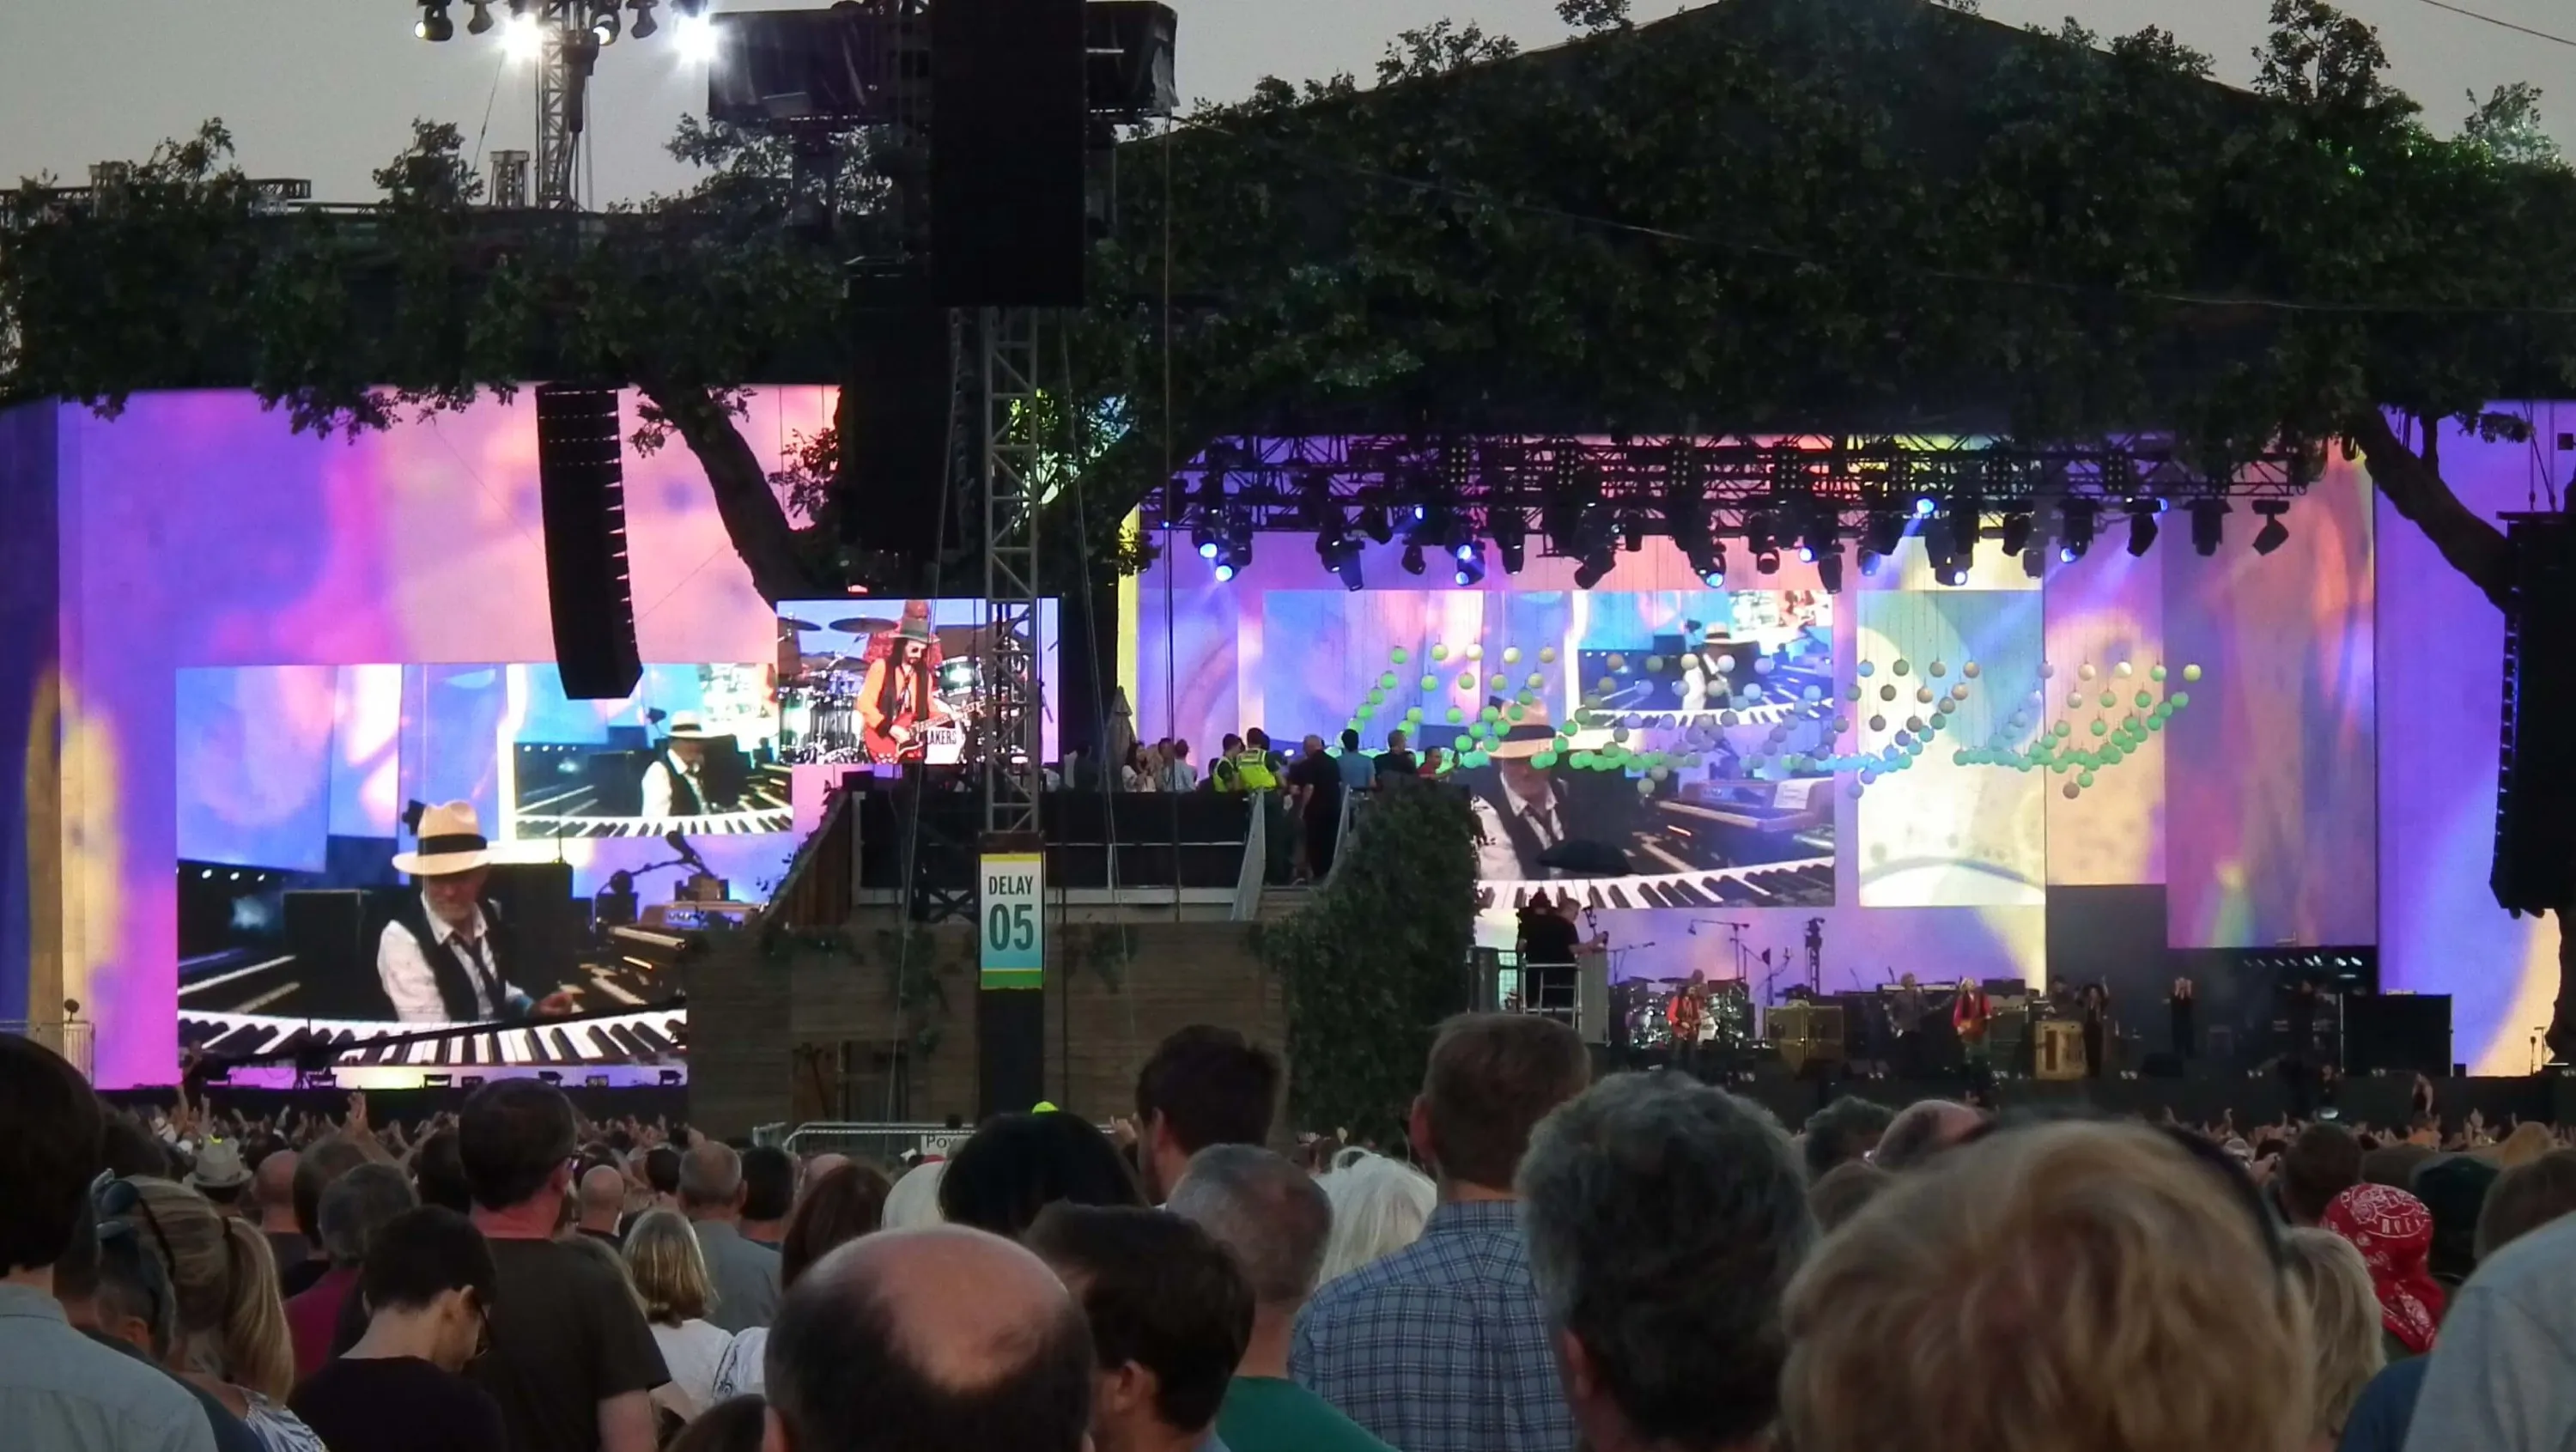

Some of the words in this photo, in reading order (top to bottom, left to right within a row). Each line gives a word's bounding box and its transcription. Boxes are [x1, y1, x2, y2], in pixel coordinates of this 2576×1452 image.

[927, 730, 957, 744] AKERS
[988, 876, 1033, 895] DELAY
[989, 903, 1034, 951] 05
